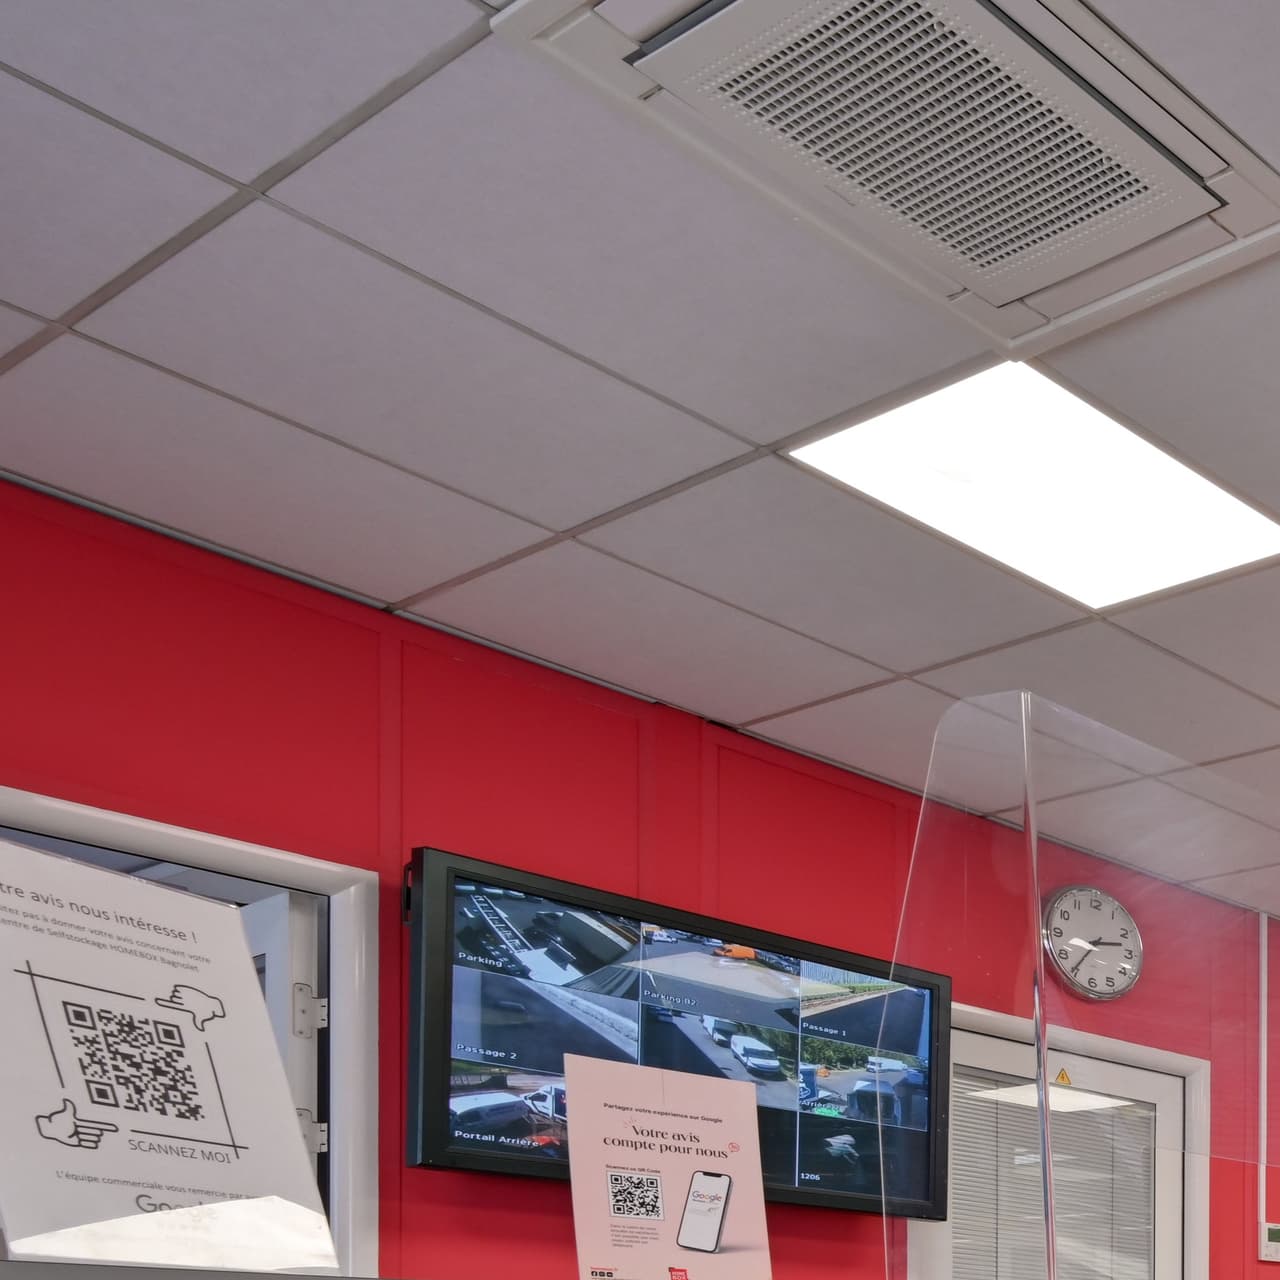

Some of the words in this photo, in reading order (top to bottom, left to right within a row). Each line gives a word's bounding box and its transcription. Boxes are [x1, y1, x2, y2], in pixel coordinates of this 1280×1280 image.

[1090, 899, 1102, 911] 12
[31, 890, 65, 908] avis
[69, 902, 111, 920] nous
[114, 912, 188, 941] intéresse
[1060, 909, 1070, 920] 10
[1053, 927, 1063, 938] 9
[1120, 928, 1129, 939] 2
[458, 951, 503, 968] Parking
[1058, 949, 1069, 960] 8
[1124, 949, 1133, 959] 3
[1088, 977, 1098, 988] 6
[1105, 977, 1115, 987] 5
[644, 989, 681, 1004] Parking
[802, 1022, 839, 1035] Passage
[456, 1043, 506, 1058] Passage
[510, 1052, 518, 1060] 2
[454, 1130, 495, 1142] Portail
[632, 1125, 668, 1139] Votre
[672, 1132, 701, 1143] avis
[128, 1139, 198, 1159] SCANNEZ
[200, 1149, 232, 1164] MOI
[603, 1137, 656, 1151] compte
[659, 1143, 693, 1155] pour
[695, 1148, 729, 1159] nous
[101, 1177, 164, 1192] commerciale
[165, 1183, 187, 1193] vous
[692, 1190, 722, 1203] Google
